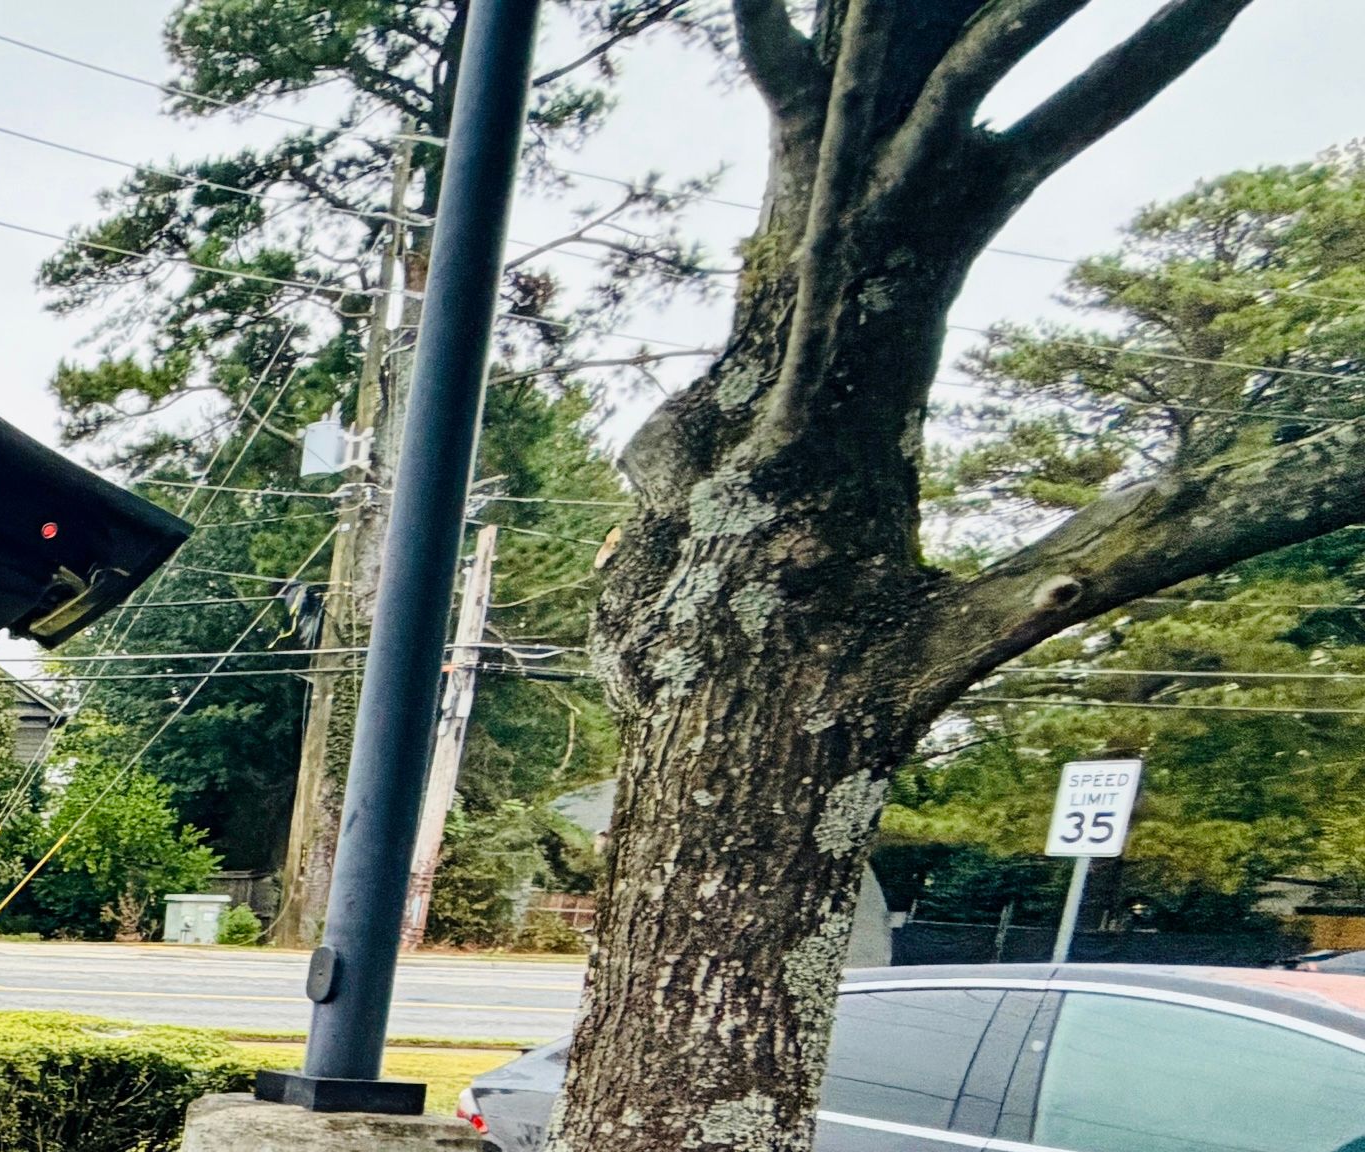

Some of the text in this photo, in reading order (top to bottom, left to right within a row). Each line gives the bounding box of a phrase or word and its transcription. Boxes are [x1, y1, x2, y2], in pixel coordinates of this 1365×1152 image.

[1068, 772, 1130, 788] SPEED
[1069, 792, 1119, 807] LIMIT
[1059, 811, 1117, 844] 35
